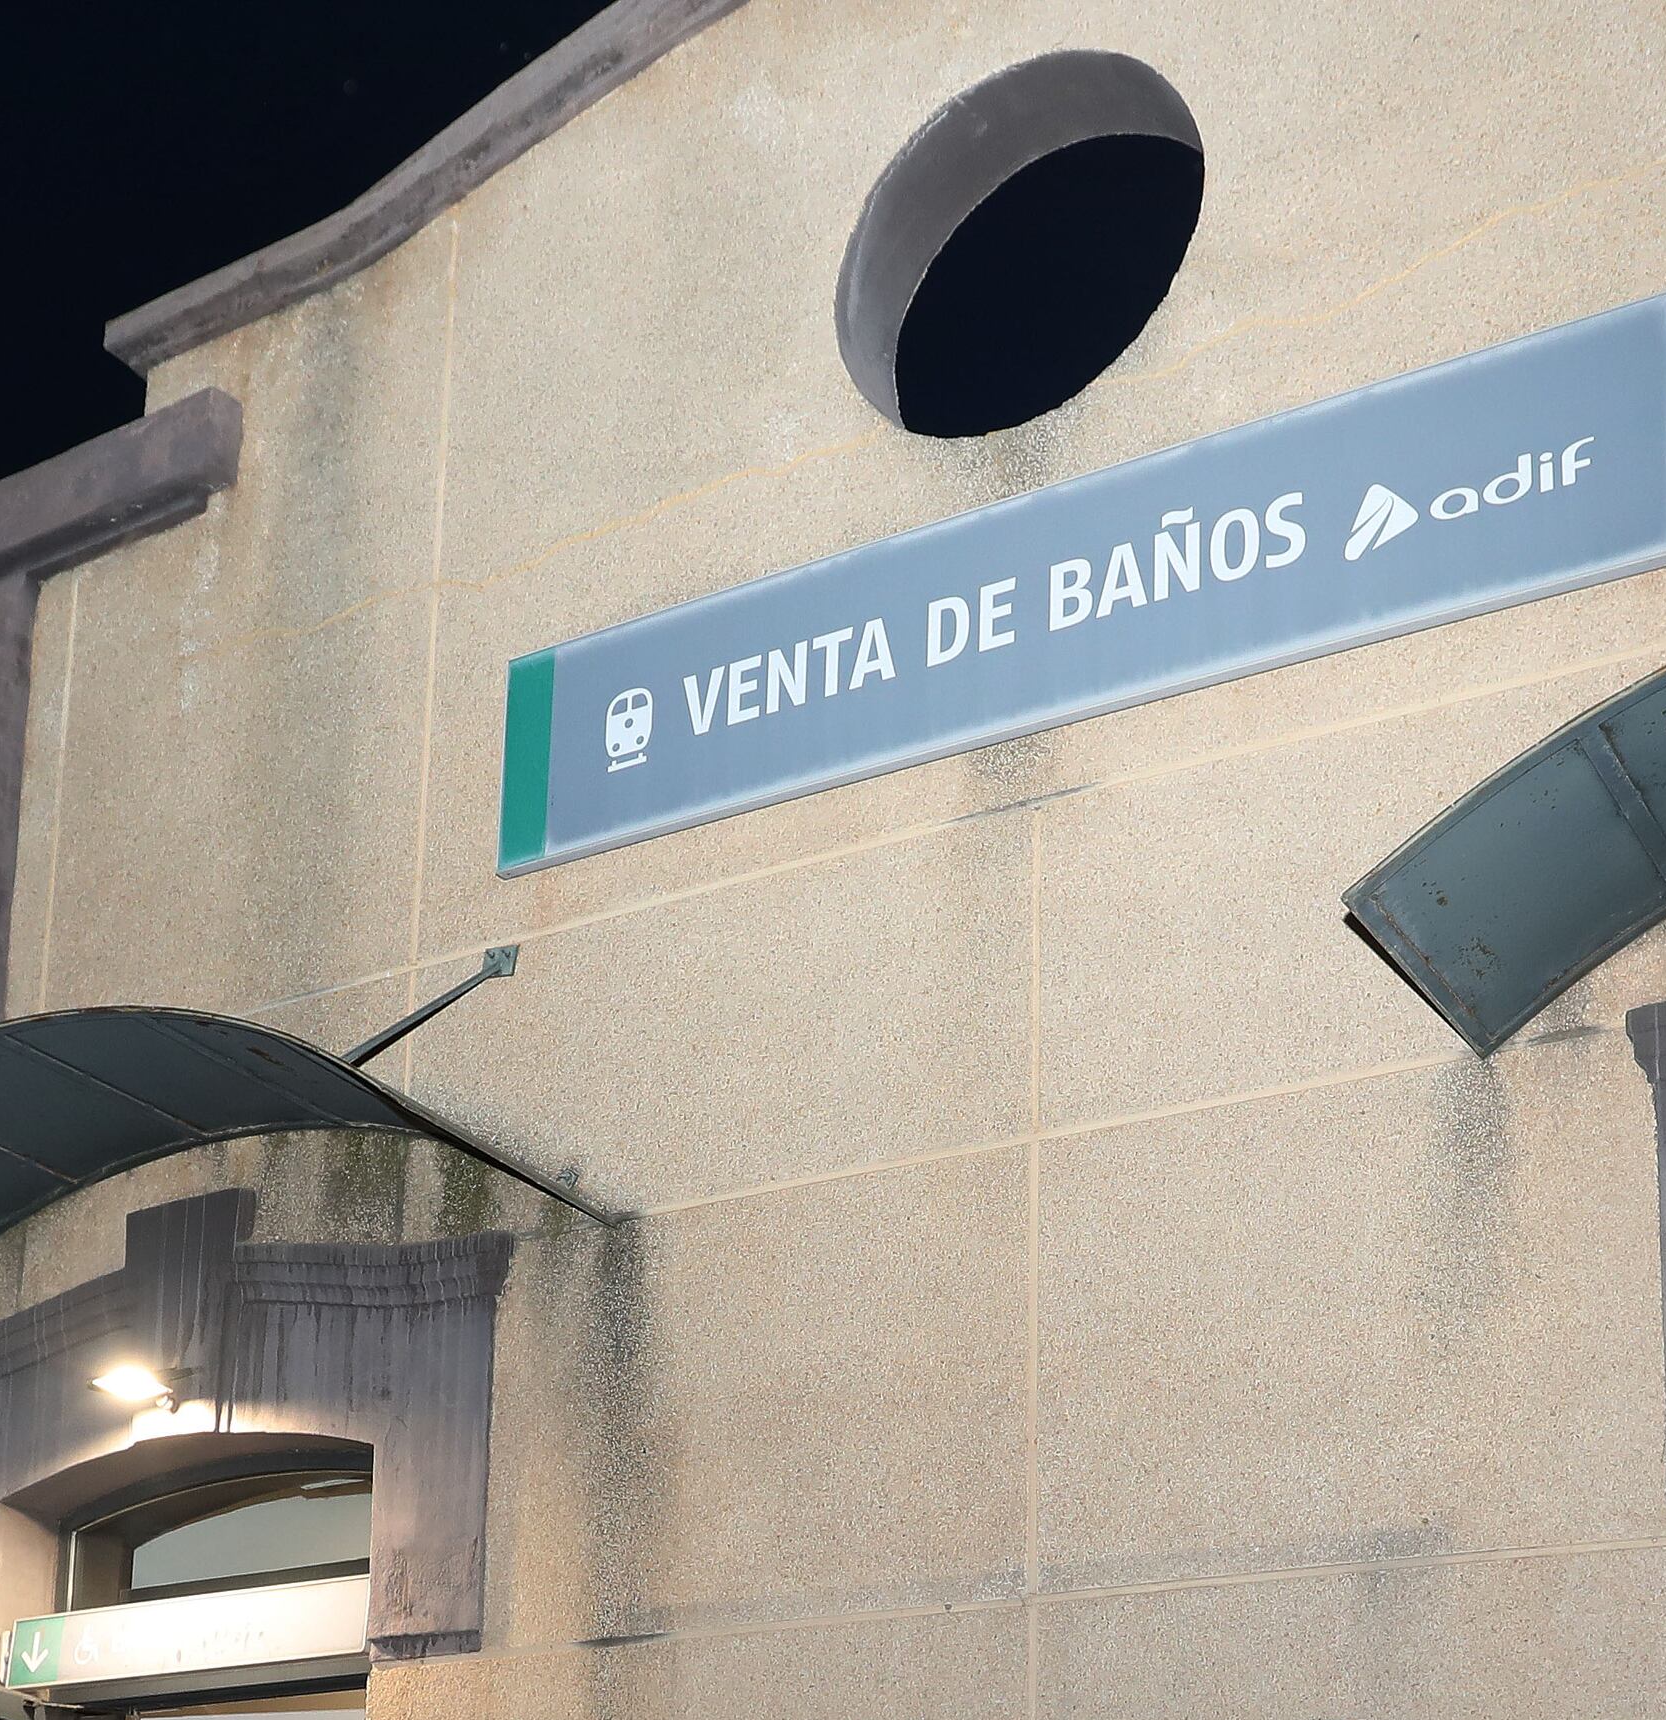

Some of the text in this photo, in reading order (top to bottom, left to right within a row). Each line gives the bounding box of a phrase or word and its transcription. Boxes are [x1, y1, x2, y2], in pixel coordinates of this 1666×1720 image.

[1429, 434, 1596, 521] adif
[682, 490, 1308, 737] VENTA DE BAÑOS
